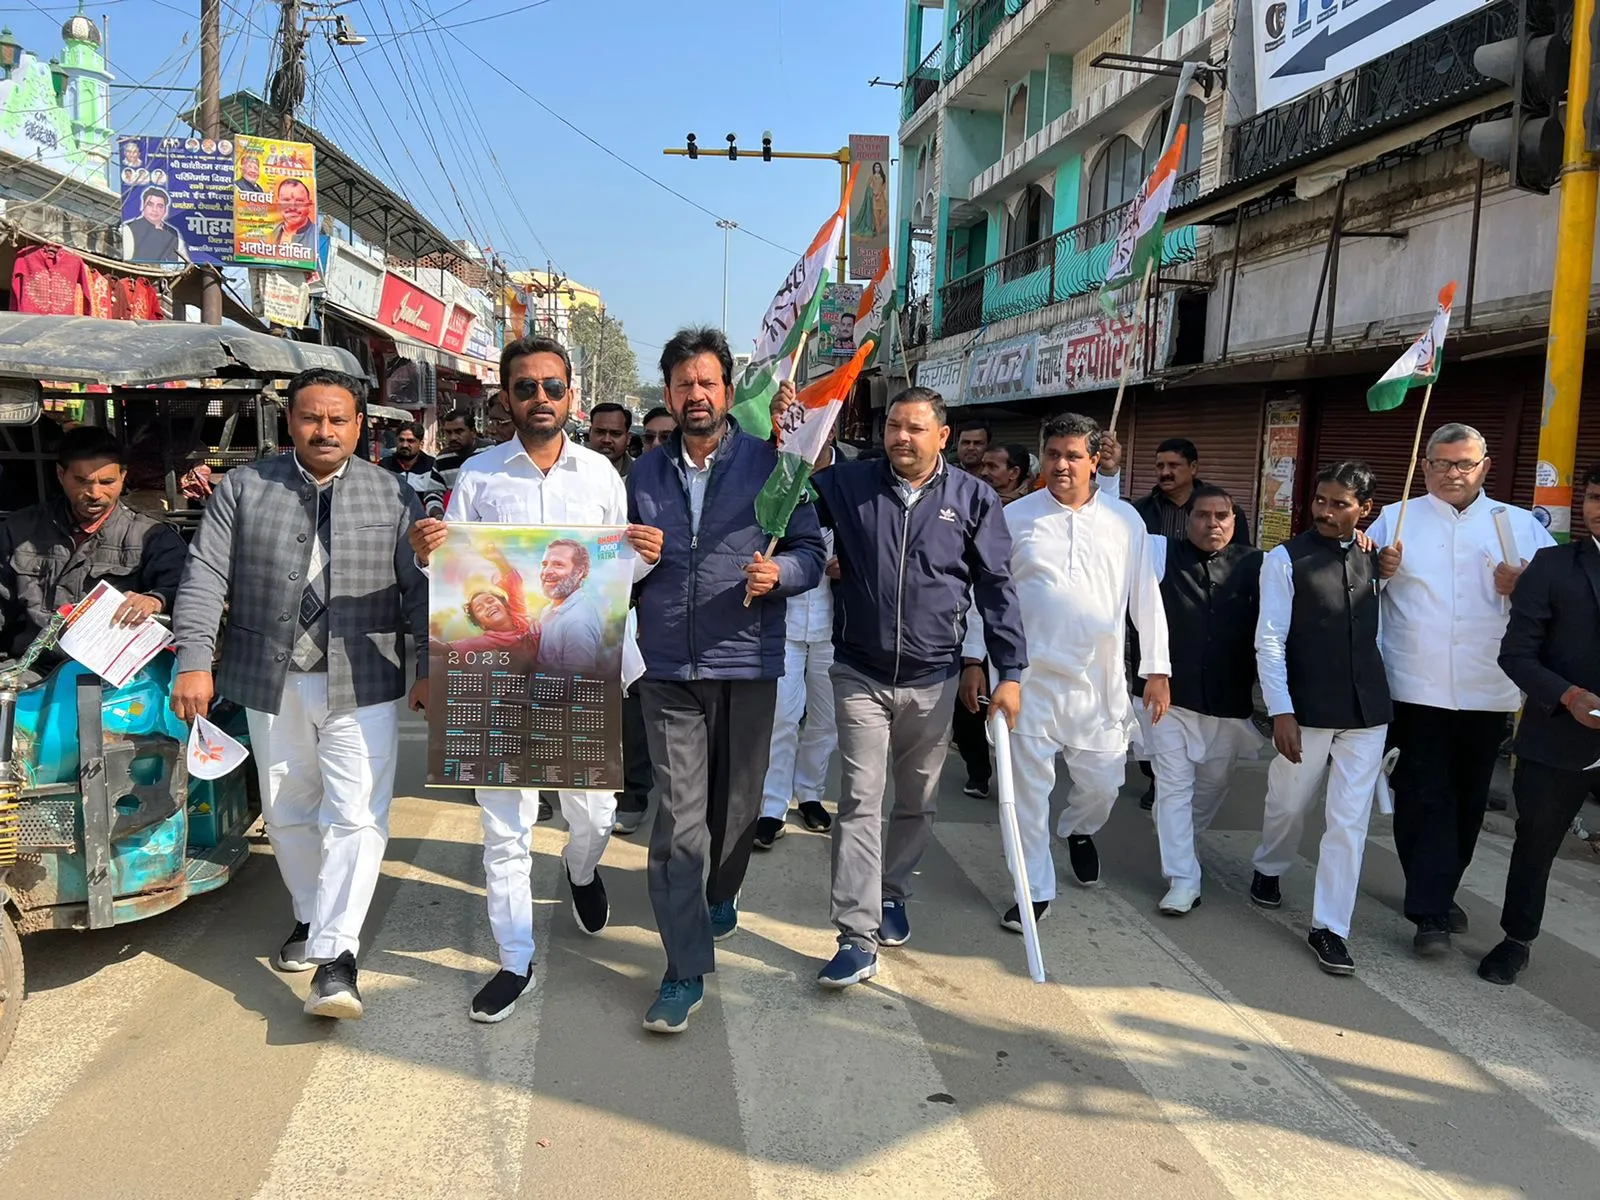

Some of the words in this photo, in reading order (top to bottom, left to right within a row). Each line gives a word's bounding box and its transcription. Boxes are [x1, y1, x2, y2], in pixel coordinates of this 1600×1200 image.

[238, 190, 275, 205] नववर्ष
[239, 239, 277, 257] अवधेश
[278, 243, 312, 260] दीक्षित
[448, 650, 511, 666] 2023
